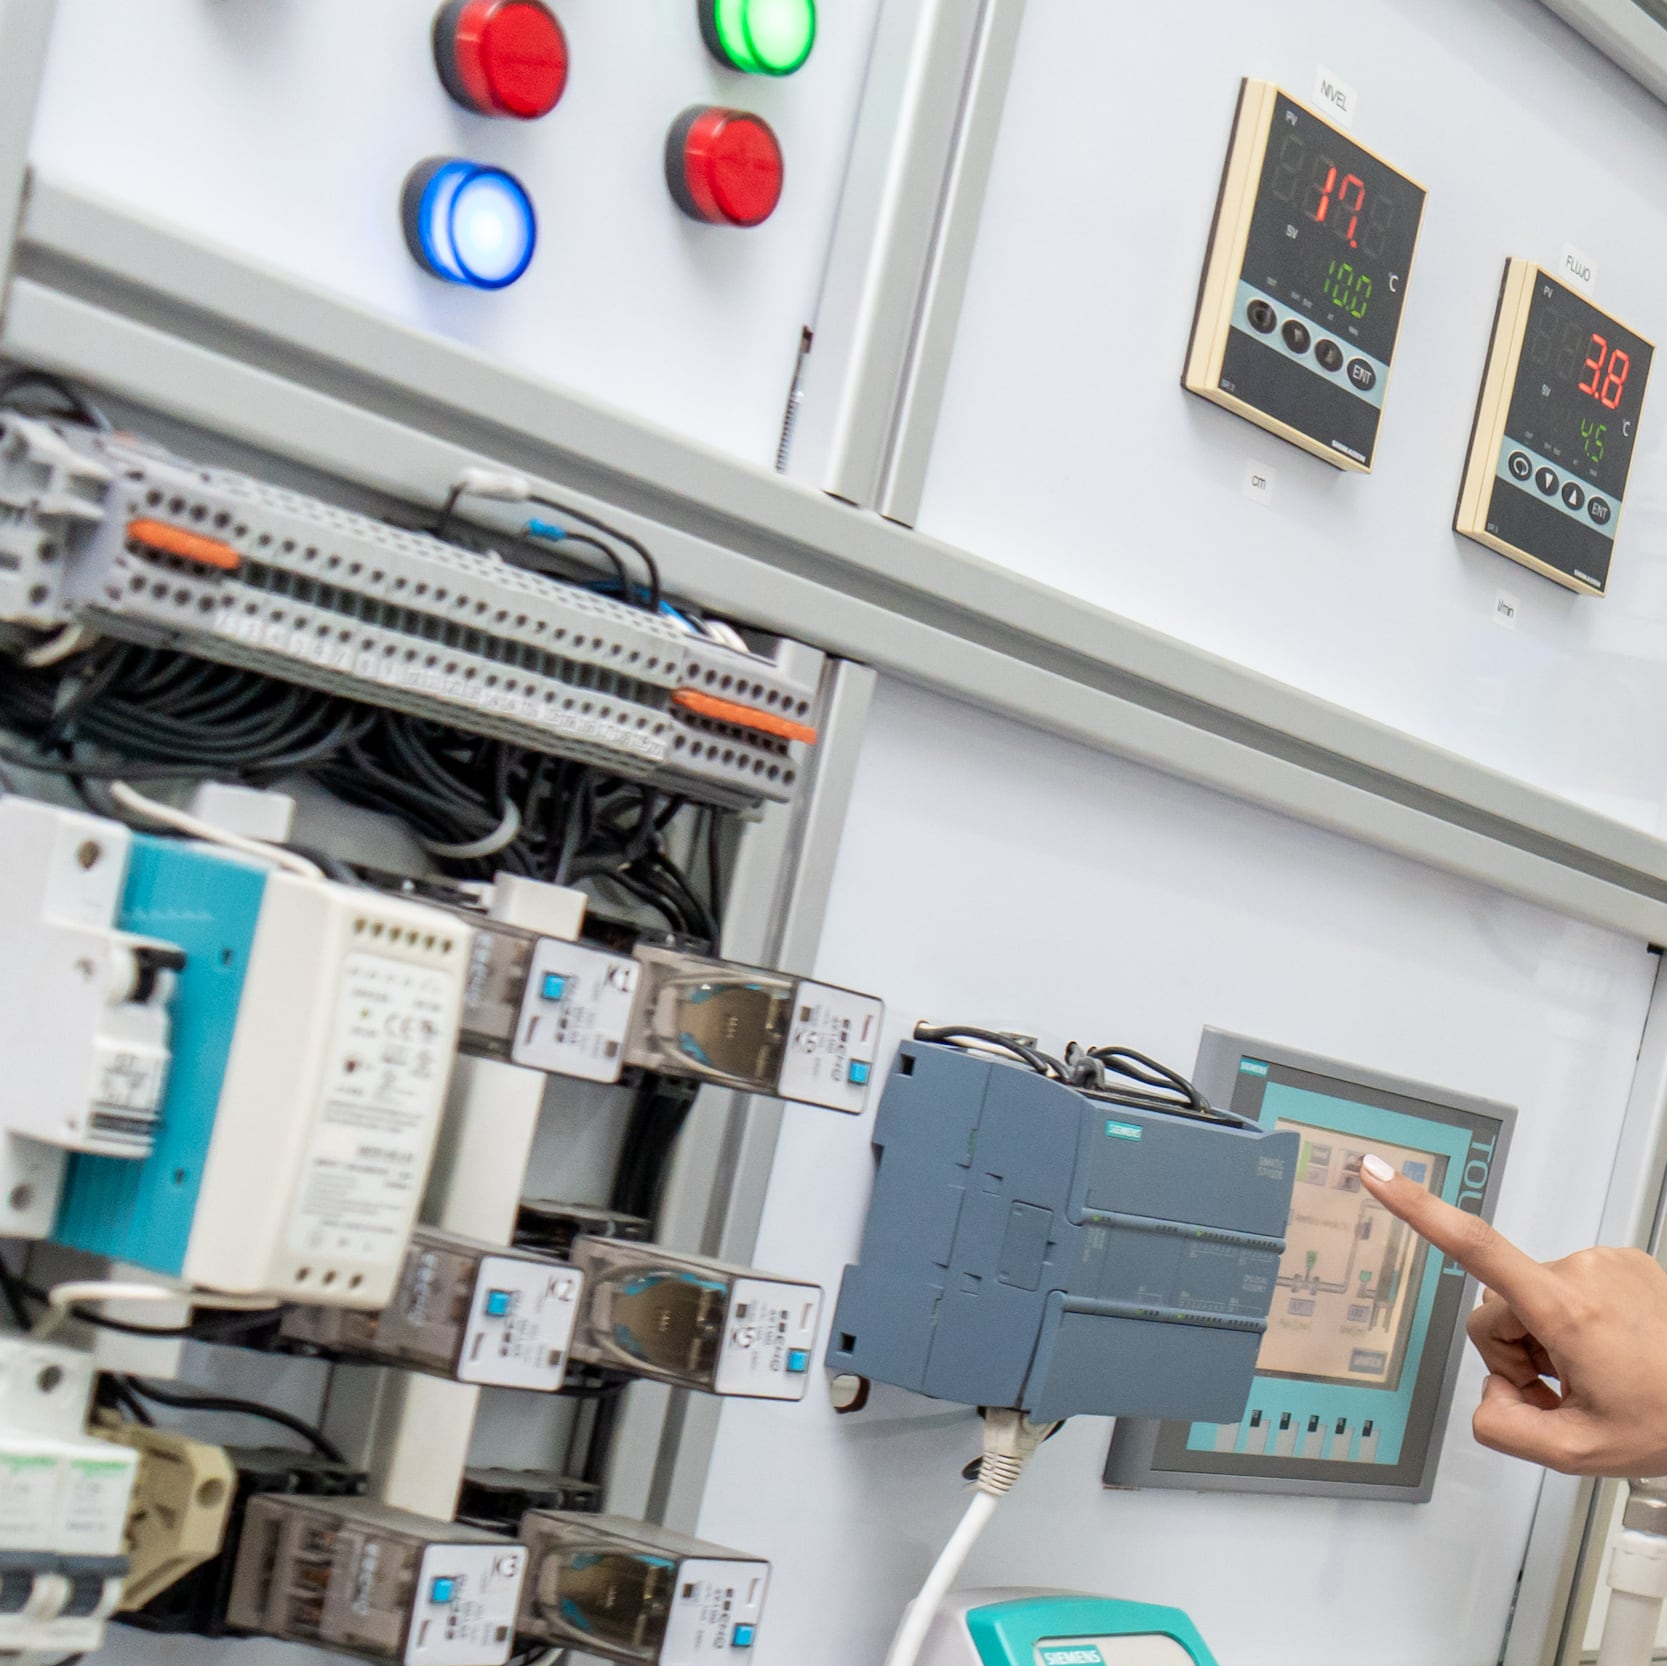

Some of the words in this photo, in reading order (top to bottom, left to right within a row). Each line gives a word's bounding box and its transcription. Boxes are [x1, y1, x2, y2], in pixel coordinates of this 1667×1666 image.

[1320, 80, 1347, 112] NIVEL
[1285, 110, 1298, 126] PV
[1286, 224, 1299, 240] SV
[1566, 255, 1592, 282] FLUJO
[1543, 285, 1553, 299] PV
[1351, 364, 1373, 385] ENT
[1578, 333, 1630, 410] 3.8
[1251, 475, 1266, 490] cm
[1591, 502, 1608, 520] ENT
[605, 964, 631, 993] K1
[545, 1274, 574, 1302] K2
[491, 1555, 519, 1578] K3
[1044, 1650, 1101, 1666] SIEMENS
